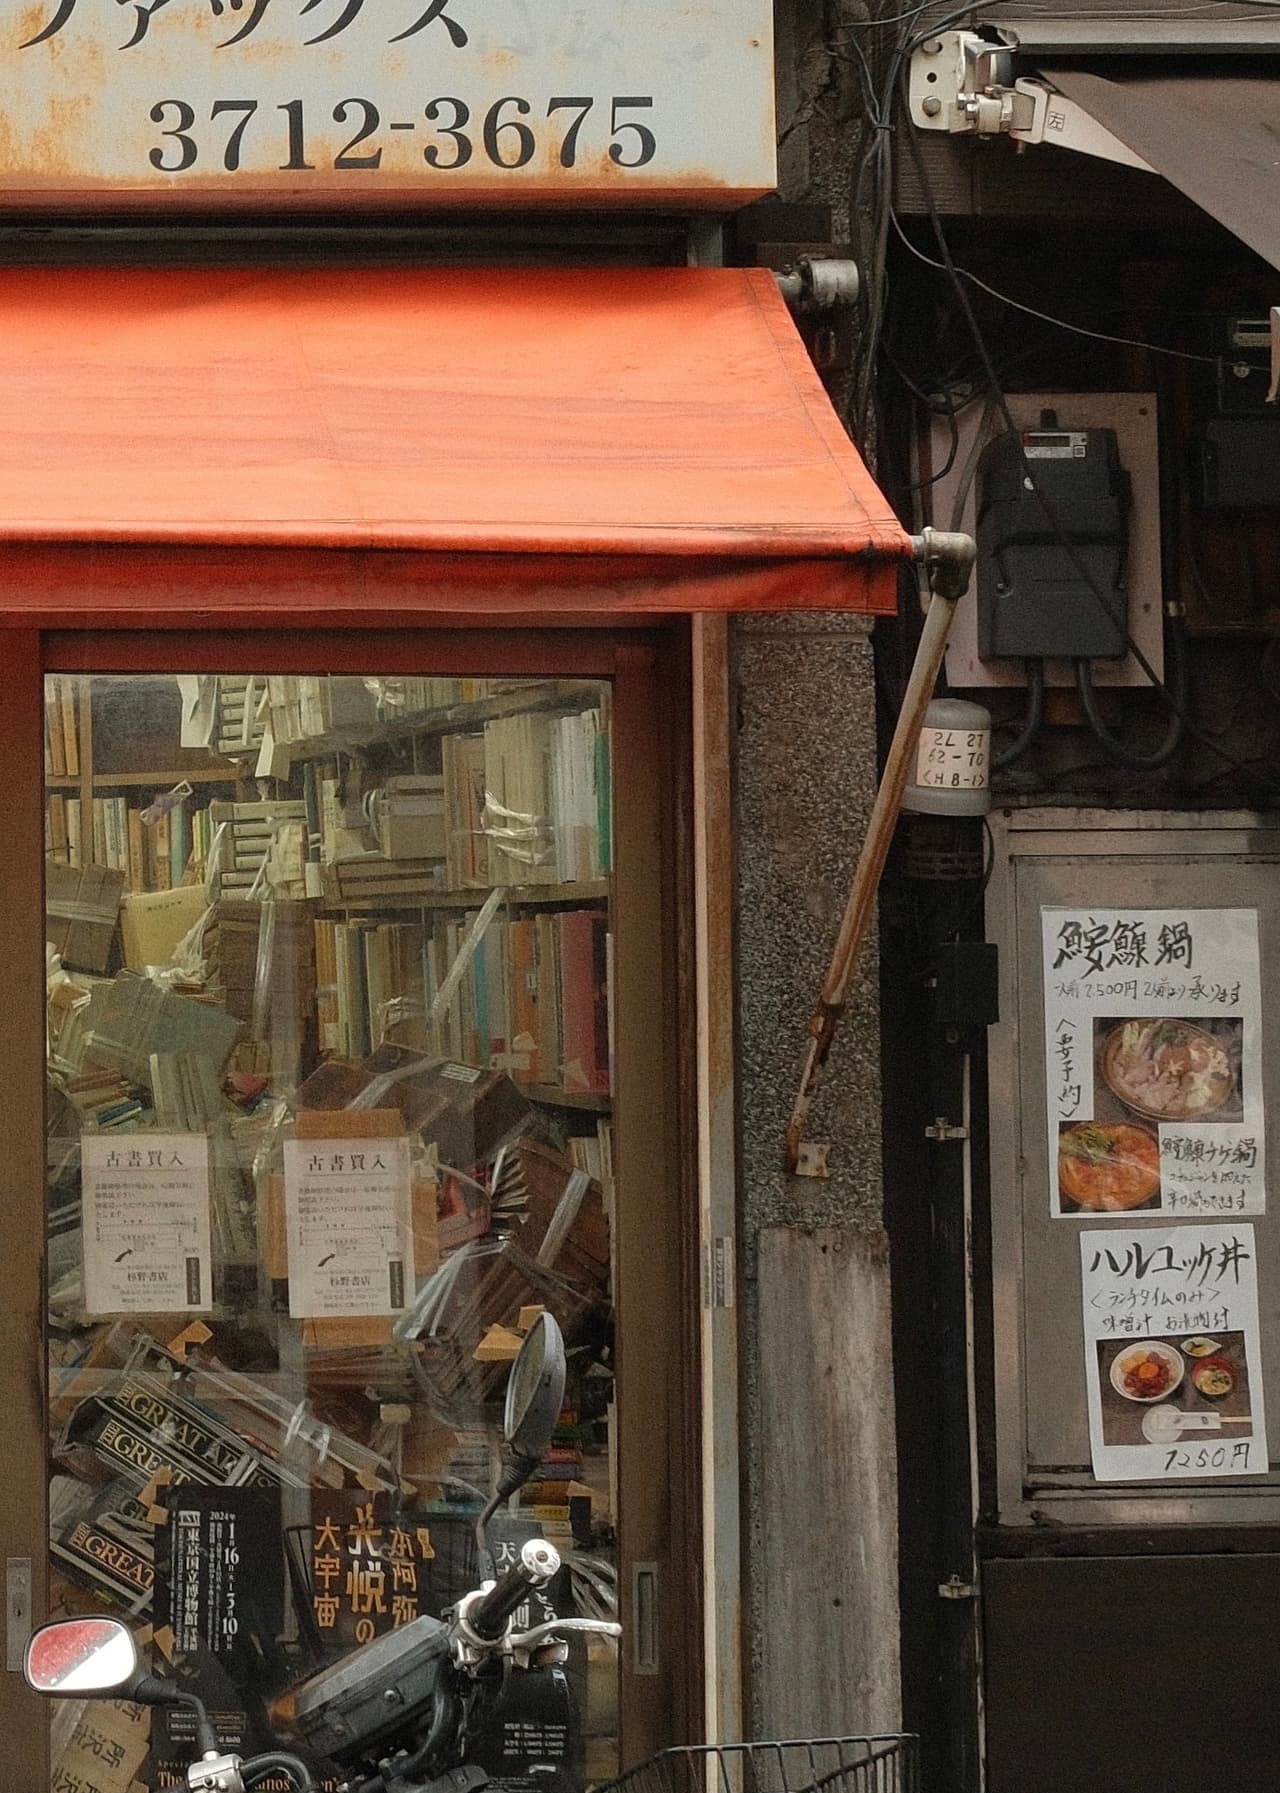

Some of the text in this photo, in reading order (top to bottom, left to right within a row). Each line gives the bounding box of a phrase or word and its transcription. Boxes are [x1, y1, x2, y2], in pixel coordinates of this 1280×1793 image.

[148, 95, 658, 173] 3712-3675
[934, 731, 955, 747] 2L
[106, 1150, 184, 1167] 古書買入
[308, 1154, 387, 1172] 古書買入
[1165, 1443, 1251, 1472] 1250円
[313, 1516, 341, 1629] 大宇宙
